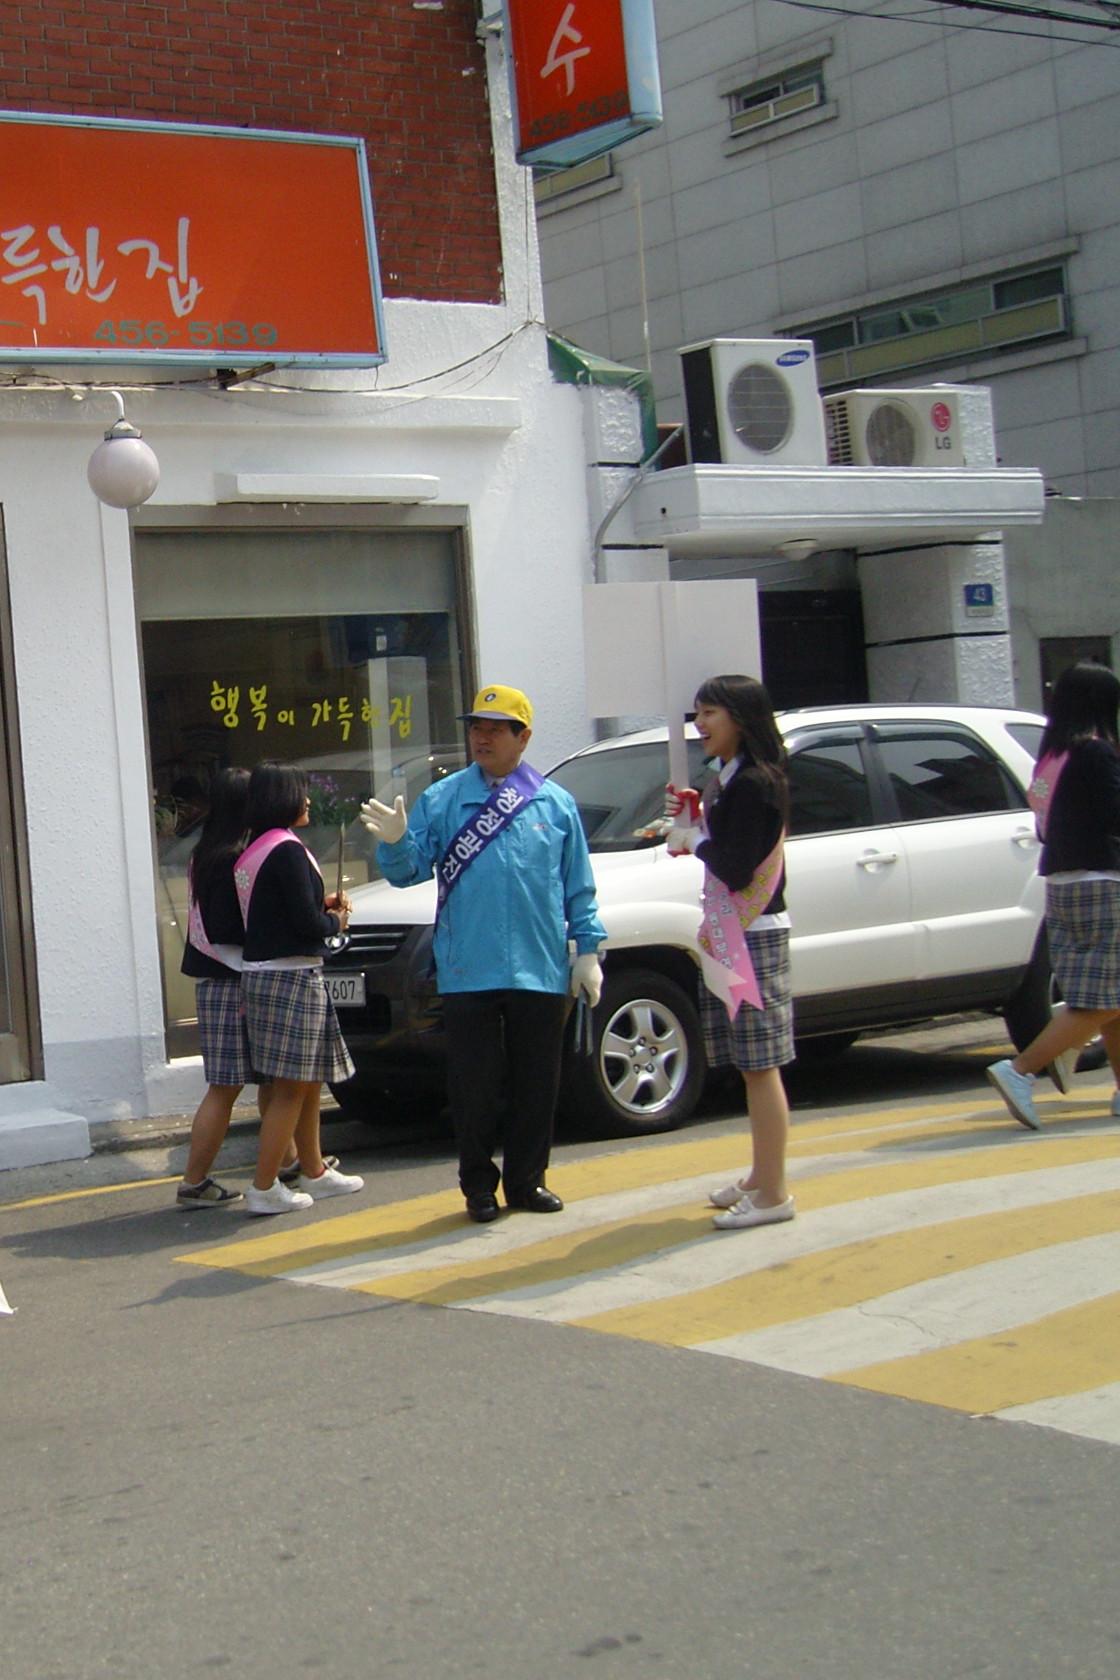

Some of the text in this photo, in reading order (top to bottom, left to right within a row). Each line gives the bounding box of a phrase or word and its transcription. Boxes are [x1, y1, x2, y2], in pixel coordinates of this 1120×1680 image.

[93, 320, 278, 347] 456-5139
[935, 436, 952, 450] LG
[210, 680, 295, 731] 행복이
